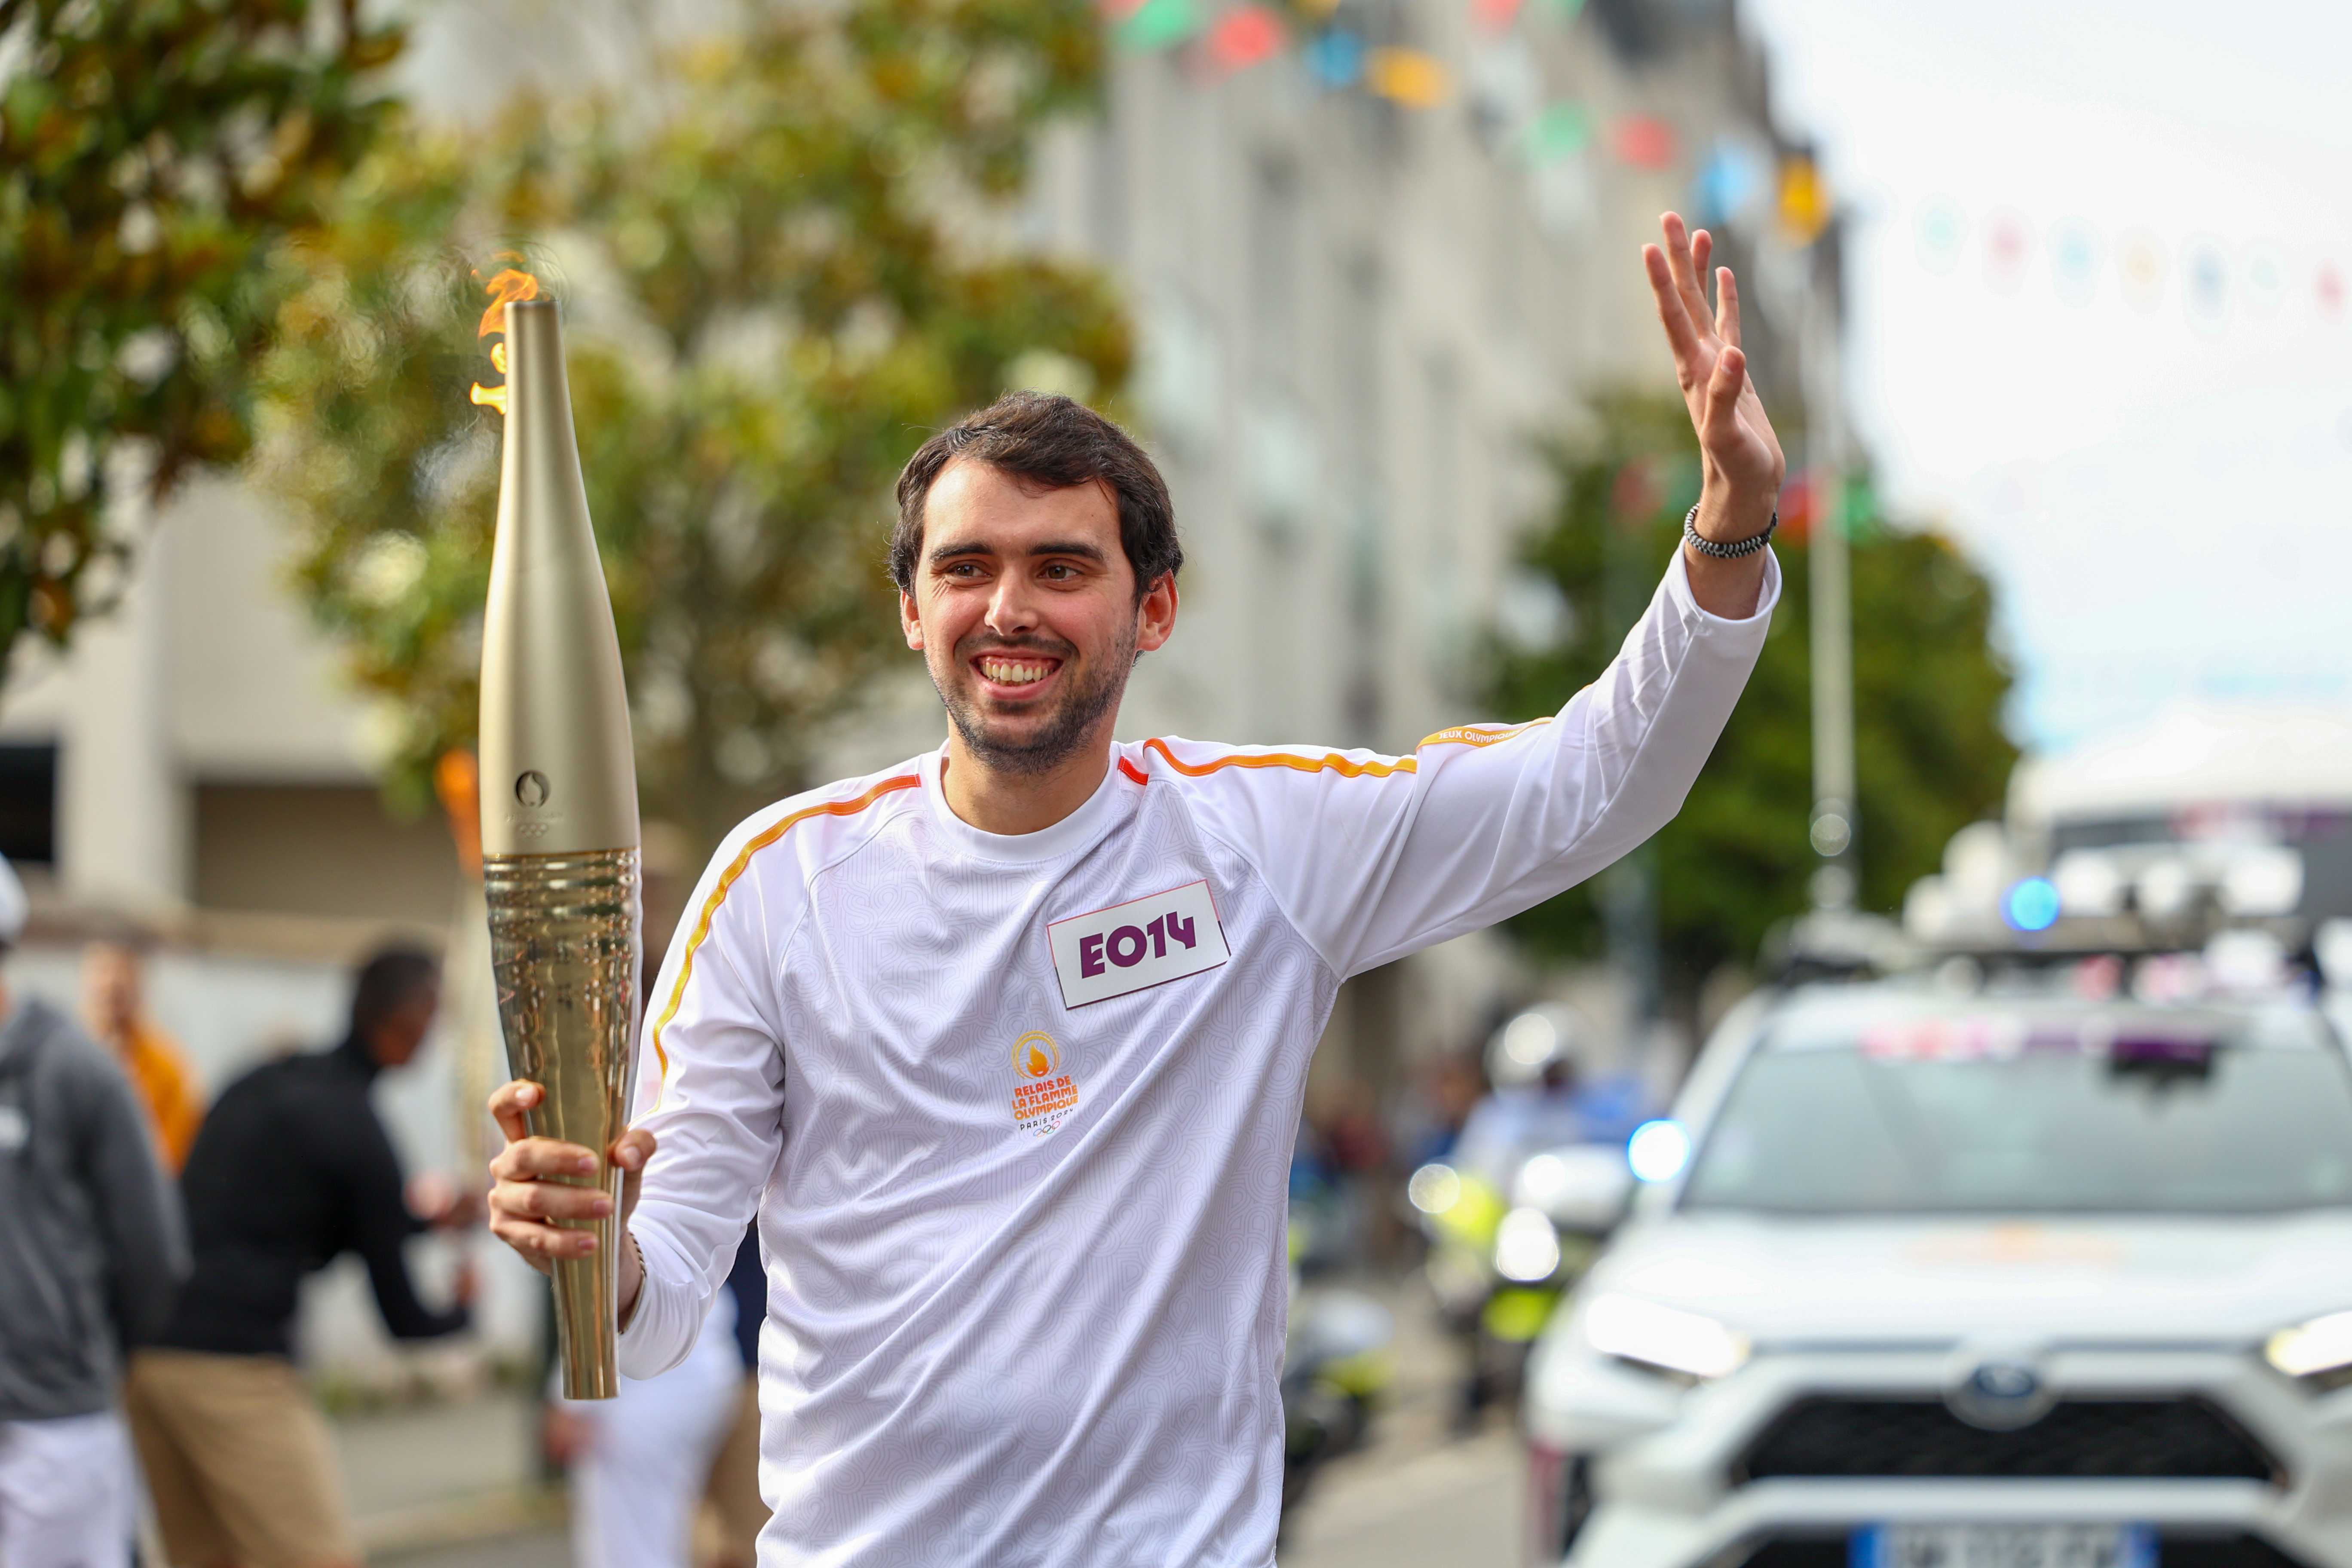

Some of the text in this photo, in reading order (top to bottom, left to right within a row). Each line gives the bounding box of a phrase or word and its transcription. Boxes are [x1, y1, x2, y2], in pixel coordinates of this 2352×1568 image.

[1439, 730, 1462, 739] JEUX
[1011, 1084, 1078, 1109] LA FLAMME
[1014, 1075, 1071, 1097] RELAIS DE
[1014, 1094, 1078, 1121] OLYMPIQUE
[1020, 1108, 1073, 1131] PARIS 2024
